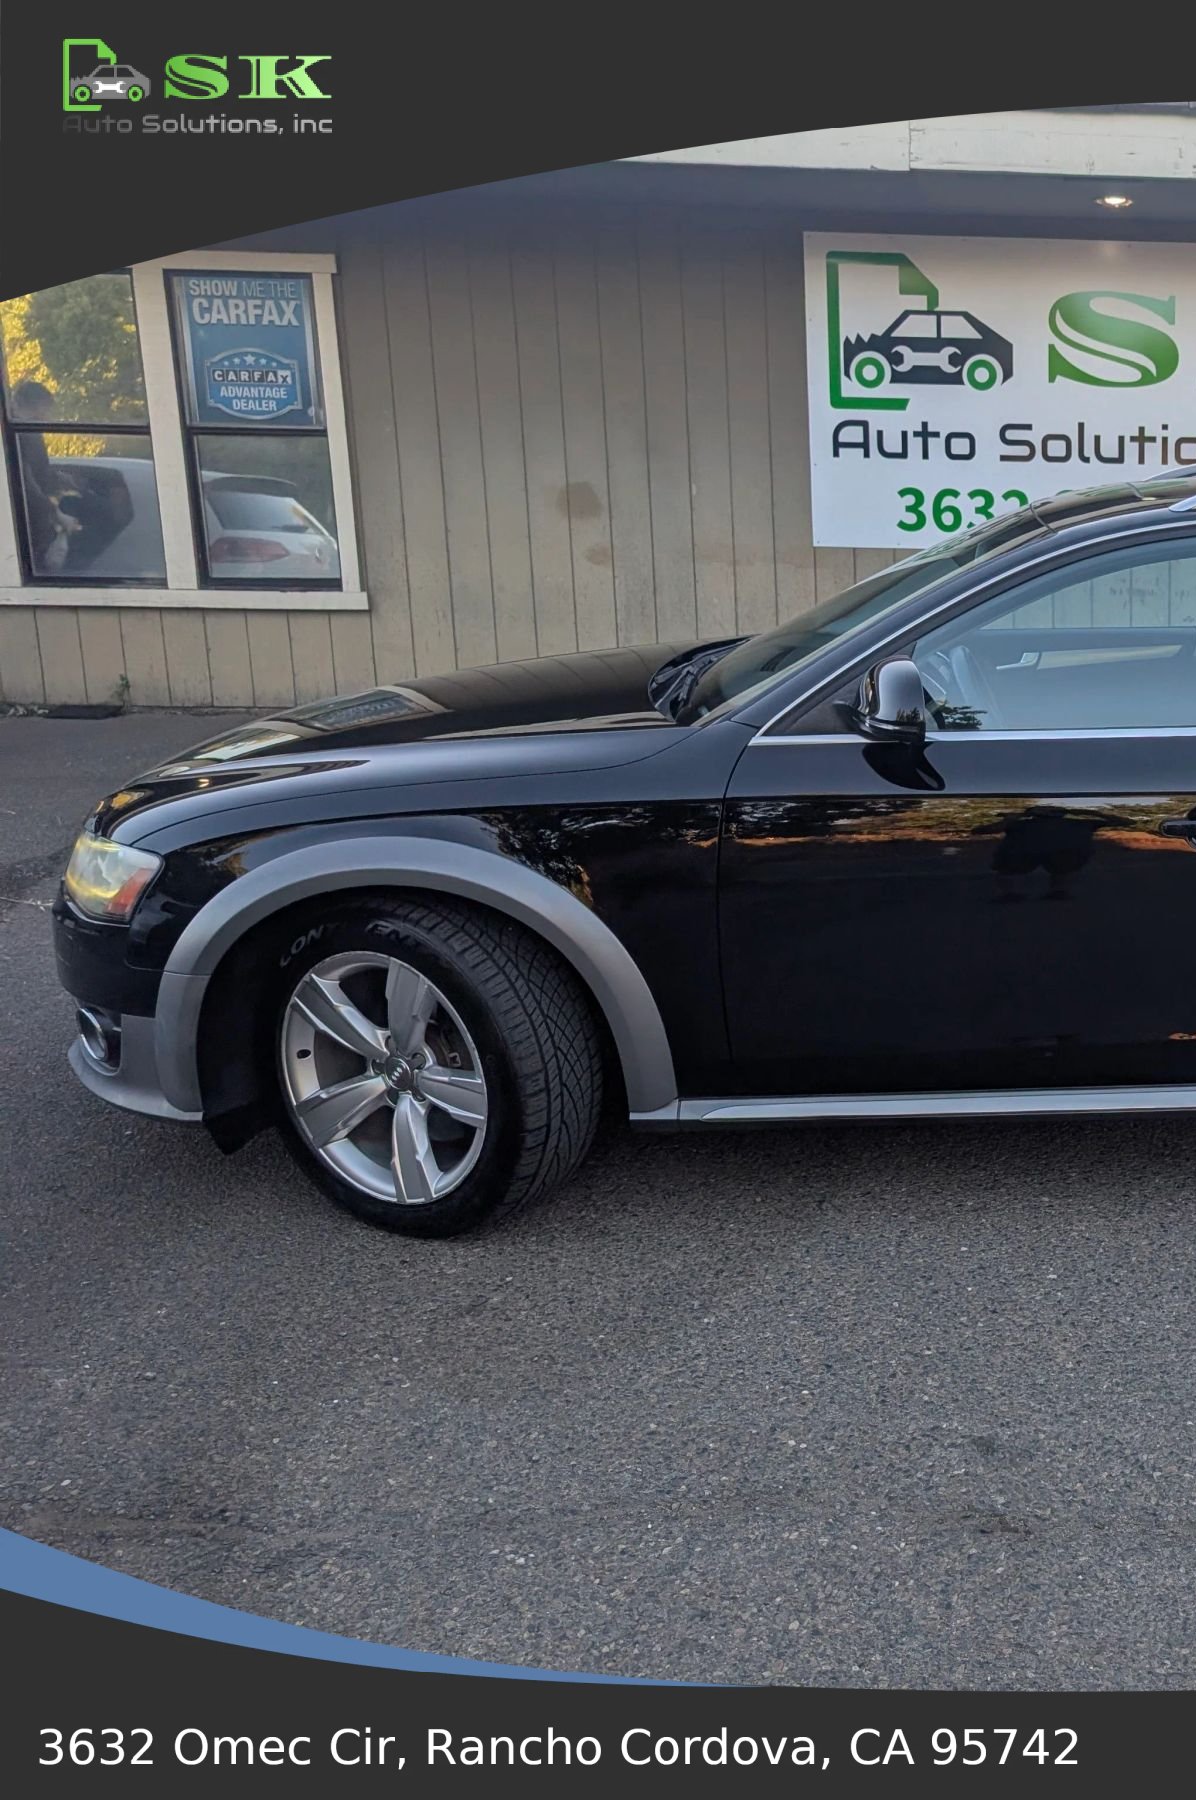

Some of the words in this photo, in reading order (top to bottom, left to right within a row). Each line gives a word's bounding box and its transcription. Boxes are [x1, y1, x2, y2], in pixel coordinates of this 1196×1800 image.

[189, 280, 238, 297] SHOW
[243, 281, 265, 297] ME
[268, 281, 298, 298] THE
[192, 298, 300, 326] CARFAX
[214, 370, 292, 384] CARFAX
[220, 386, 288, 399] ADVANTAGE
[232, 399, 278, 411] DEALER
[832, 419, 977, 461] Auto
